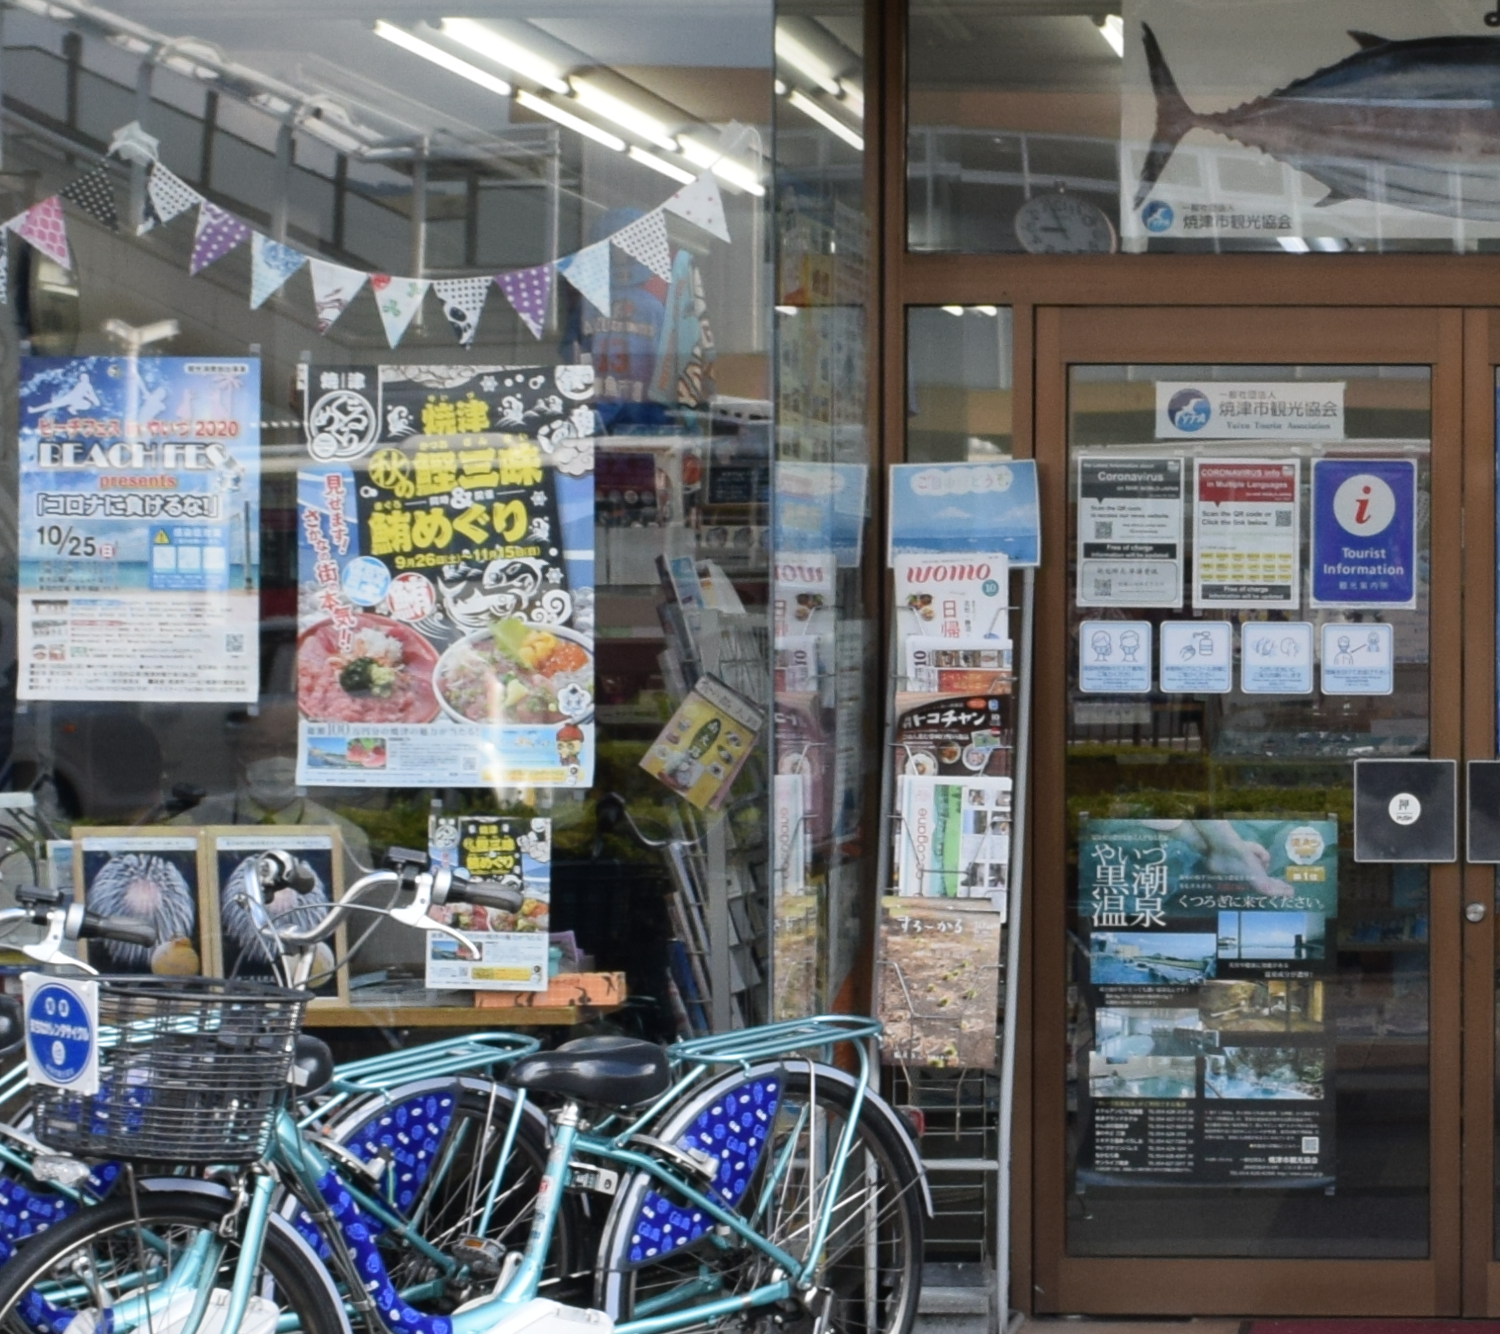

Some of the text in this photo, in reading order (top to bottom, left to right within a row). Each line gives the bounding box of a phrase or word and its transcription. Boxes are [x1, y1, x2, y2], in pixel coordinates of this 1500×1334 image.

[1182, 214, 1292, 230] 焼津市観光協会
[1218, 400, 1339, 417] 焼津市観光協会
[195, 421, 239, 437] 2020
[1286, 422, 1332, 430] Association
[99, 474, 177, 490] presents
[1097, 471, 1164, 482] Coronavirus
[36, 525, 97, 557] 10/25
[1341, 547, 1386, 560] Tourist
[1323, 562, 1405, 576] Information
[1091, 843, 1168, 866] やいづ
[1092, 864, 1169, 897] 黒潮
[1178, 895, 1325, 909] くつろぎに来てください。
[1091, 895, 1168, 927] 温泉
